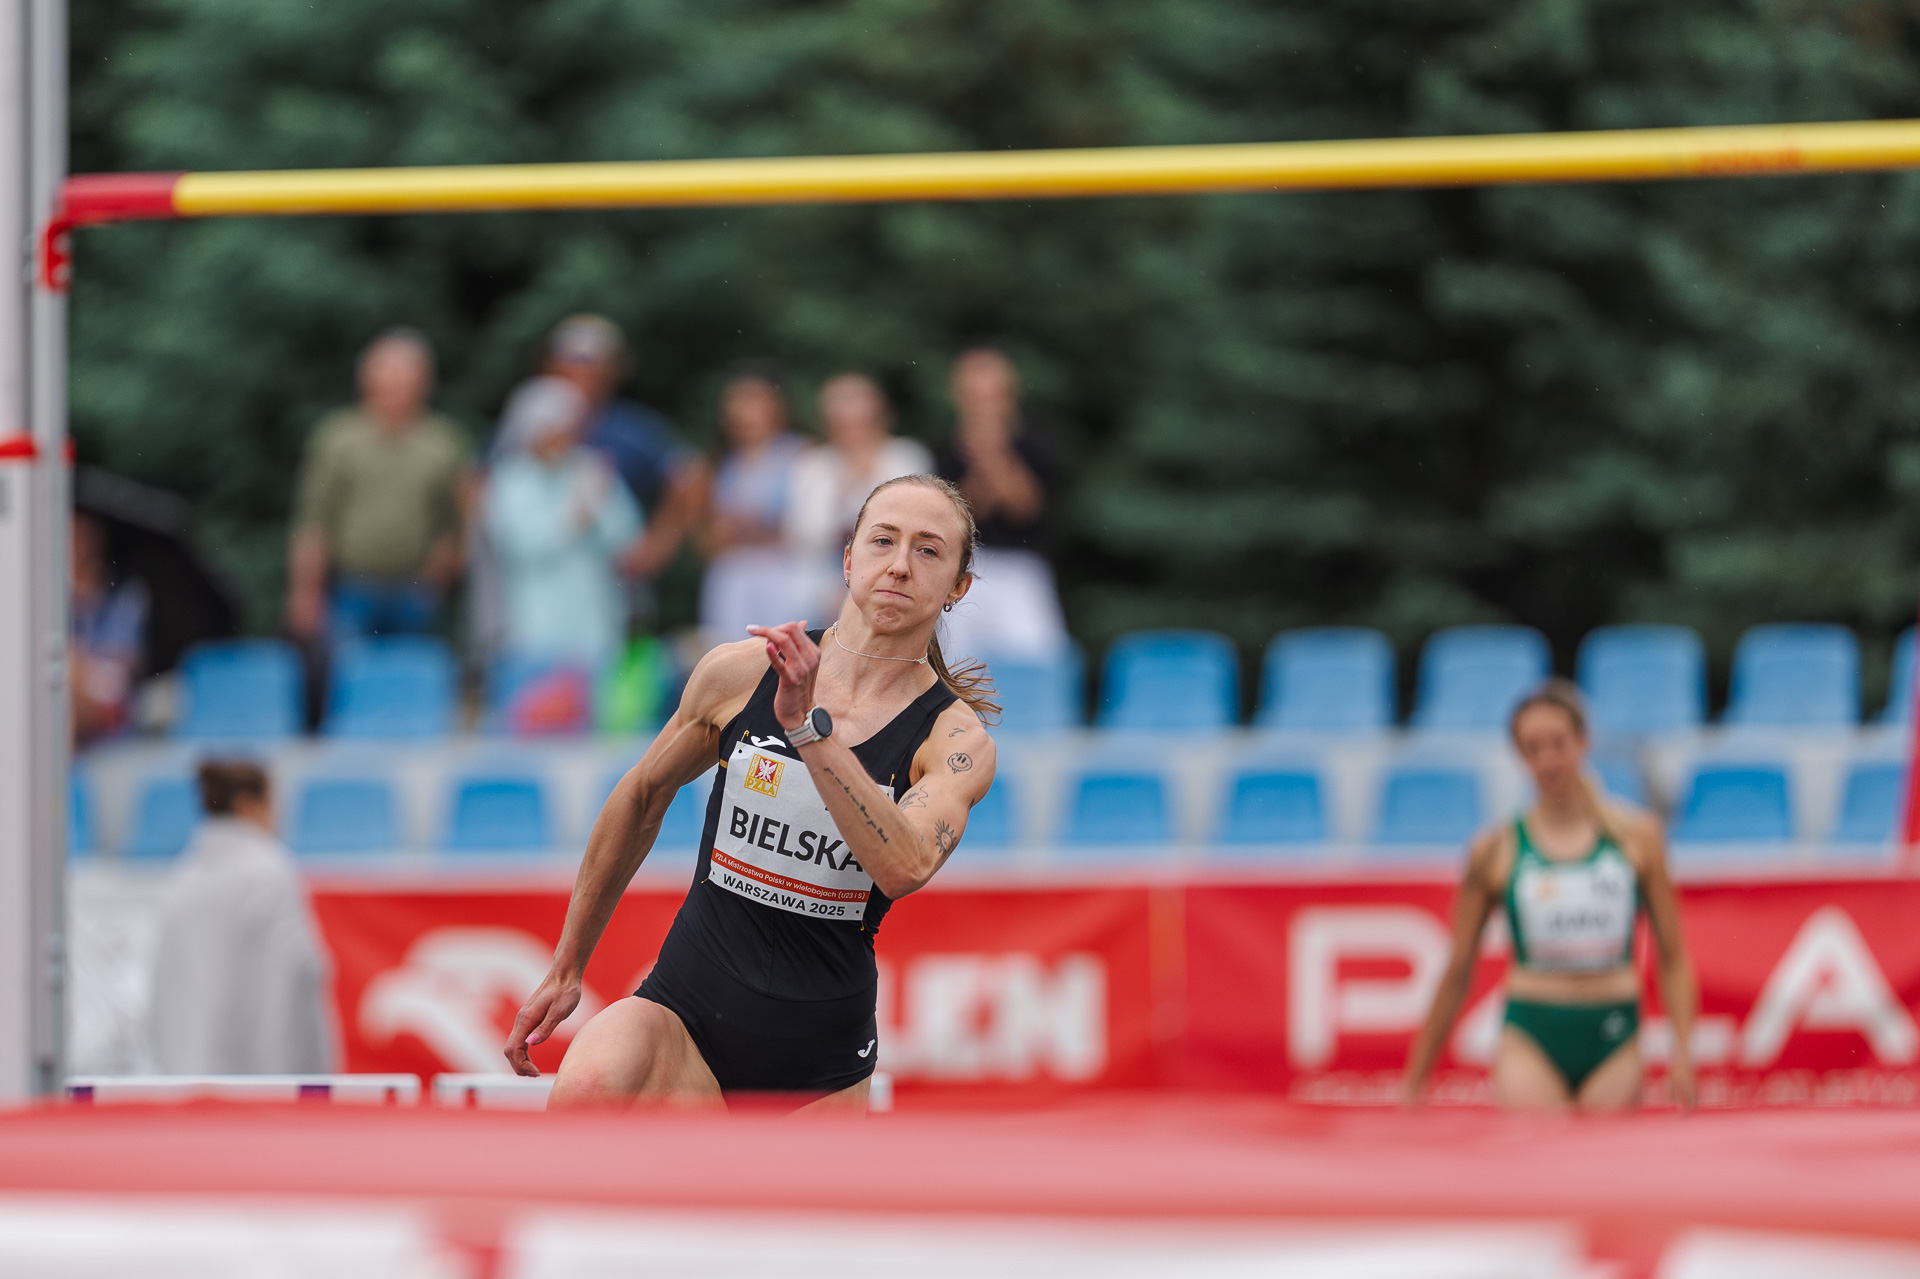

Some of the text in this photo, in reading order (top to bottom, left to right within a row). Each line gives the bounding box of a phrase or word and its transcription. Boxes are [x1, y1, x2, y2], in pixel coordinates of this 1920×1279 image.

[746, 778, 775, 795] PZLA
[729, 805, 864, 873] BIELSKA
[714, 852, 727, 864] PZLA
[727, 859, 764, 878] Mistrzostwa
[764, 873, 785, 886] Polski
[785, 880, 793, 888] w
[793, 883, 837, 898] wielobojach
[837, 890, 853, 900] (U23
[723, 873, 846, 917] WARSZAWA 2025
